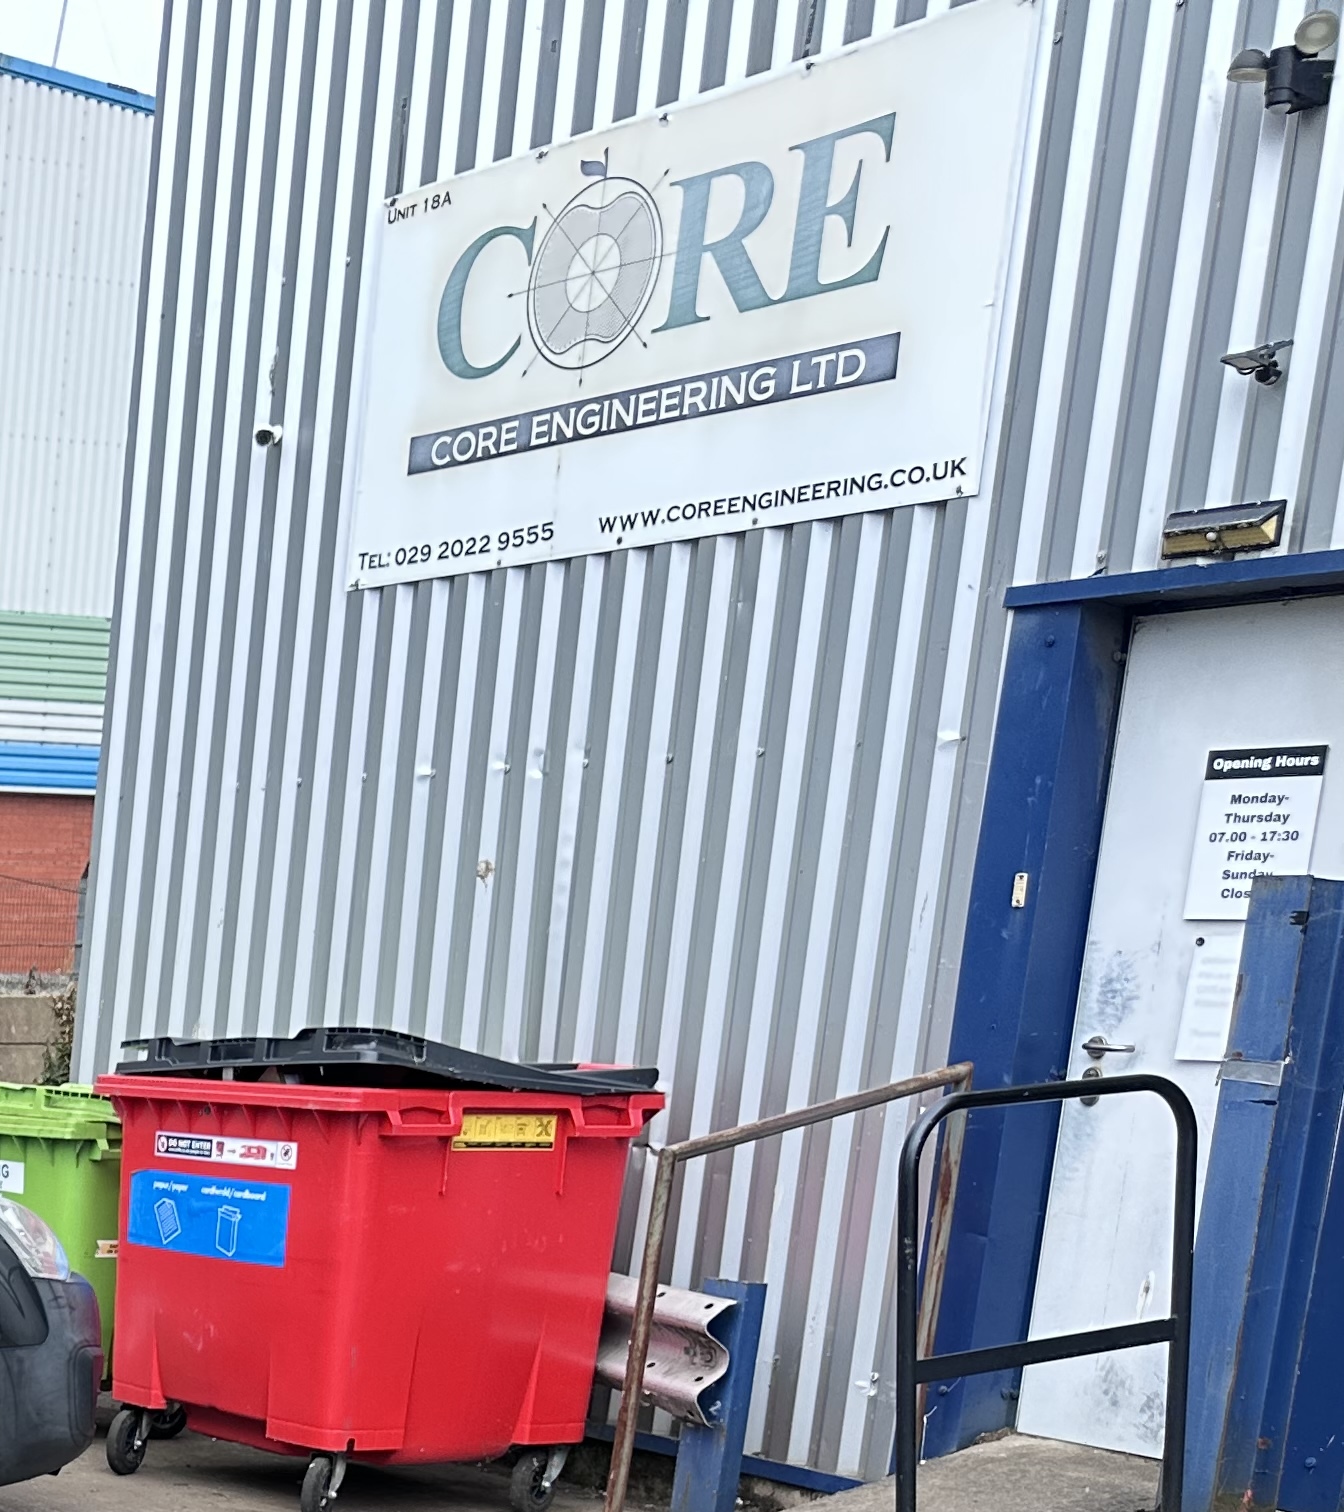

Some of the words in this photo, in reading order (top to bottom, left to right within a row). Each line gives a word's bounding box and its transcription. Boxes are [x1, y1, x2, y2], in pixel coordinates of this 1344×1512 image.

[423, 190, 452, 213] 18A
[436, 111, 897, 380] CORE
[430, 420, 519, 467] CORE
[529, 366, 776, 448] ENGINEERING
[789, 347, 868, 395] LTD
[598, 456, 967, 535] WWW.COREENGINEERING.CO.UK
[394, 541, 432, 567] 029
[437, 531, 492, 561] 2022
[497, 521, 554, 551] 9555
[1212, 756, 1272, 773] Opening
[1275, 754, 1320, 768] Hours
[1230, 792, 1290, 805] Monday-
[1224, 811, 1290, 826] Thursday
[1208, 830, 1247, 843] 07.00
[1260, 829, 1300, 842] 17:30
[1226, 850, 1275, 864] Friday-
